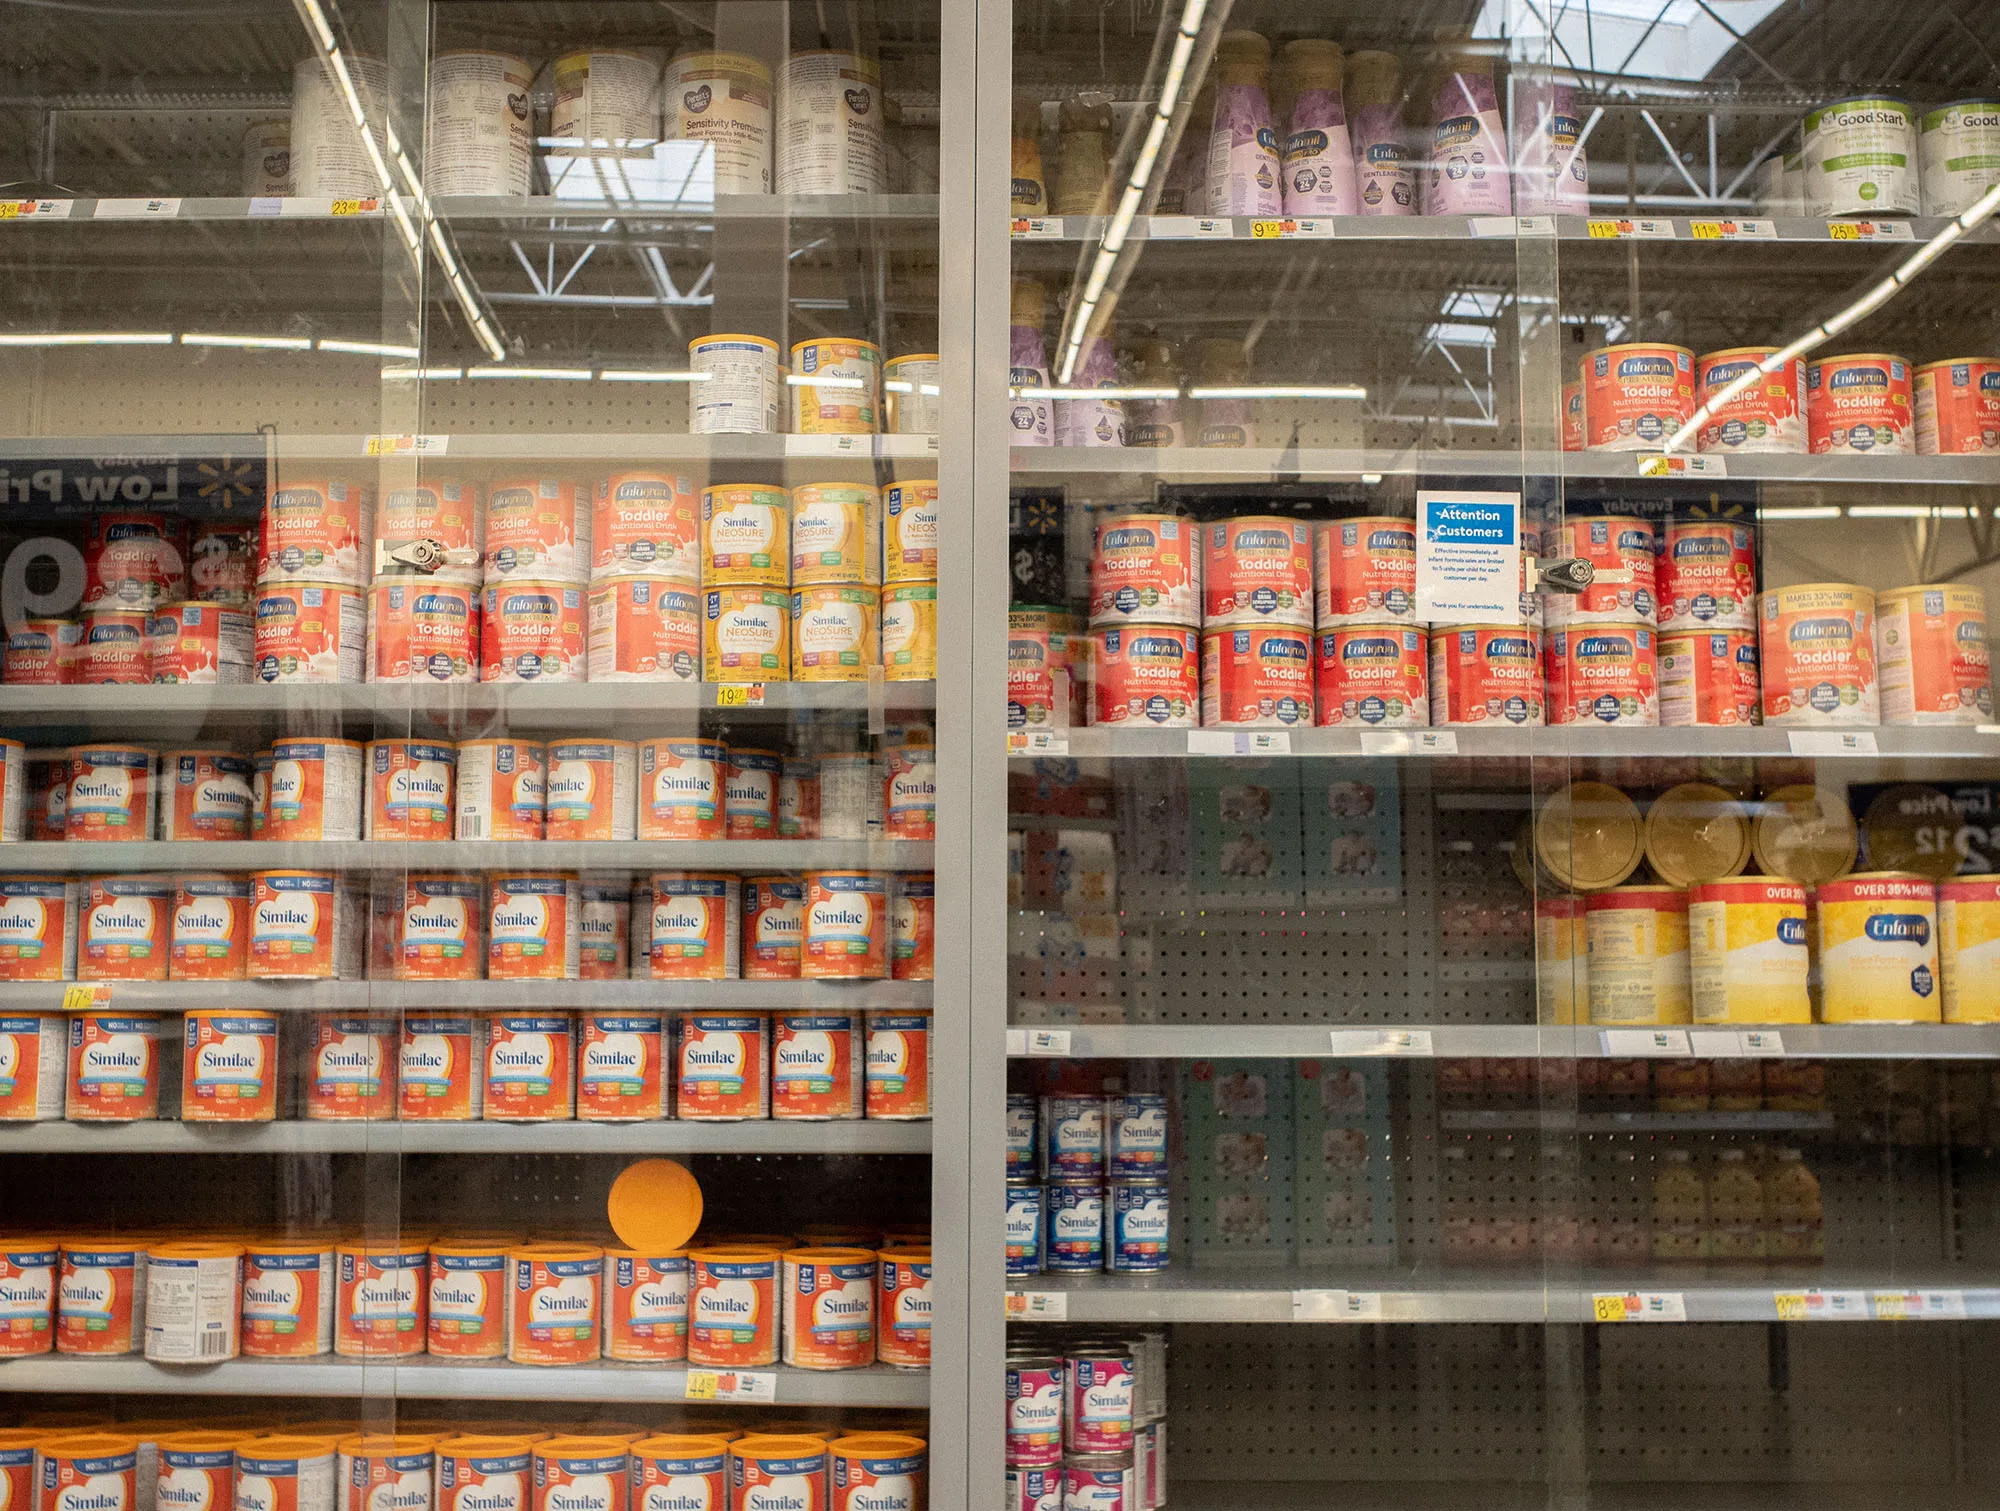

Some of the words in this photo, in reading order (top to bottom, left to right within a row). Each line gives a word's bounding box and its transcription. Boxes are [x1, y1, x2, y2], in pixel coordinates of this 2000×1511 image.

[686, 118, 729, 131] Sensitivity
[1838, 112, 1875, 126] Good
[1876, 112, 1904, 126] Start
[1963, 114, 2000, 127] Good
[332, 202, 348, 215] 23
[1254, 223, 1264, 237] 9
[1590, 224, 1603, 238] 11
[1695, 224, 1708, 238] 11
[1831, 225, 1848, 239] 25
[1622, 386, 1673, 398] Toddler
[1613, 399, 1657, 407] Nutritional
[1659, 399, 1681, 407] Drink
[1834, 396, 1886, 407] Toddler
[1825, 409, 1869, 417] Nutritional
[1871, 408, 1894, 417] Drink
[1017, 417, 1029, 426] 24
[618, 510, 669, 522] Toddler
[1440, 509, 1500, 521] Attention
[272, 517, 319, 530] Toddler
[387, 517, 435, 529] Toddler
[490, 517, 531, 530] Toddler
[610, 522, 654, 531] Nutritional
[655, 522, 677, 530] Drink
[723, 516, 759, 528] Similac
[799, 517, 828, 528] Similac
[1437, 525, 1503, 538] Customers
[109, 550, 156, 561] Toddler
[1104, 558, 1154, 570] Toddler
[1238, 558, 1289, 570] Toddler
[1371, 559, 1416, 571] Toddler
[1230, 571, 1271, 579] Nutritional
[1677, 566, 1728, 576] Toddler
[1786, 594, 1811, 602] MAKES
[733, 616, 769, 627] Similac
[812, 615, 847, 626] Similac
[1025, 614, 1046, 623] MORE
[257, 624, 294, 637] Toddler
[417, 624, 465, 637] Toddler
[505, 624, 556, 635] Toddler
[498, 636, 540, 645] Nutritional
[90, 651, 136, 663] Toddler
[1794, 651, 1851, 664] Toddler
[8, 659, 49, 670] Toddler
[1133, 666, 1181, 678] Toddler
[1263, 667, 1306, 680] Toddler
[1346, 668, 1397, 679] Toddler
[1490, 666, 1535, 679] Toddler
[1580, 666, 1631, 677] Toddler
[720, 689, 734, 704] 19
[396, 776, 444, 794] Similac
[662, 776, 711, 790] Similac
[75, 783, 122, 798] Similac
[1766, 887, 1791, 899] OVER
[1854, 884, 1885, 897] OVER
[1887, 883, 1911, 896] 35%
[95, 914, 146, 928] Similac
[259, 909, 309, 925] Similac
[409, 914, 459, 929] Similac
[495, 912, 538, 927] Similac
[655, 914, 699, 928] Similac
[814, 910, 863, 924] Similac
[1873, 917, 1928, 938] Enfamil
[89, 1051, 141, 1067] Similac
[203, 1052, 255, 1067] Similac
[495, 1050, 543, 1065] Similac
[588, 1051, 636, 1065] Similac
[1124, 1125, 1163, 1138] Similac
[1059, 1215, 1098, 1228] Similac
[1128, 1216, 1166, 1229] Similac
[246, 1287, 290, 1303] Similac
[361, 1287, 411, 1302] Similac
[539, 1295, 589, 1311] Similac
[700, 1295, 749, 1312] Similac
[824, 1298, 869, 1313] Similac
[1597, 1299, 1608, 1318] 8
[1089, 1393, 1129, 1407] Similac
[1016, 1405, 1057, 1419] Similac
[158, 1488, 201, 1503] Similac
[65, 1494, 119, 1511] Similac
[463, 1494, 516, 1511] Similac
[552, 1494, 605, 1511] Similac
[650, 1494, 702, 1511] Similac
[855, 1494, 909, 1511] Similac
